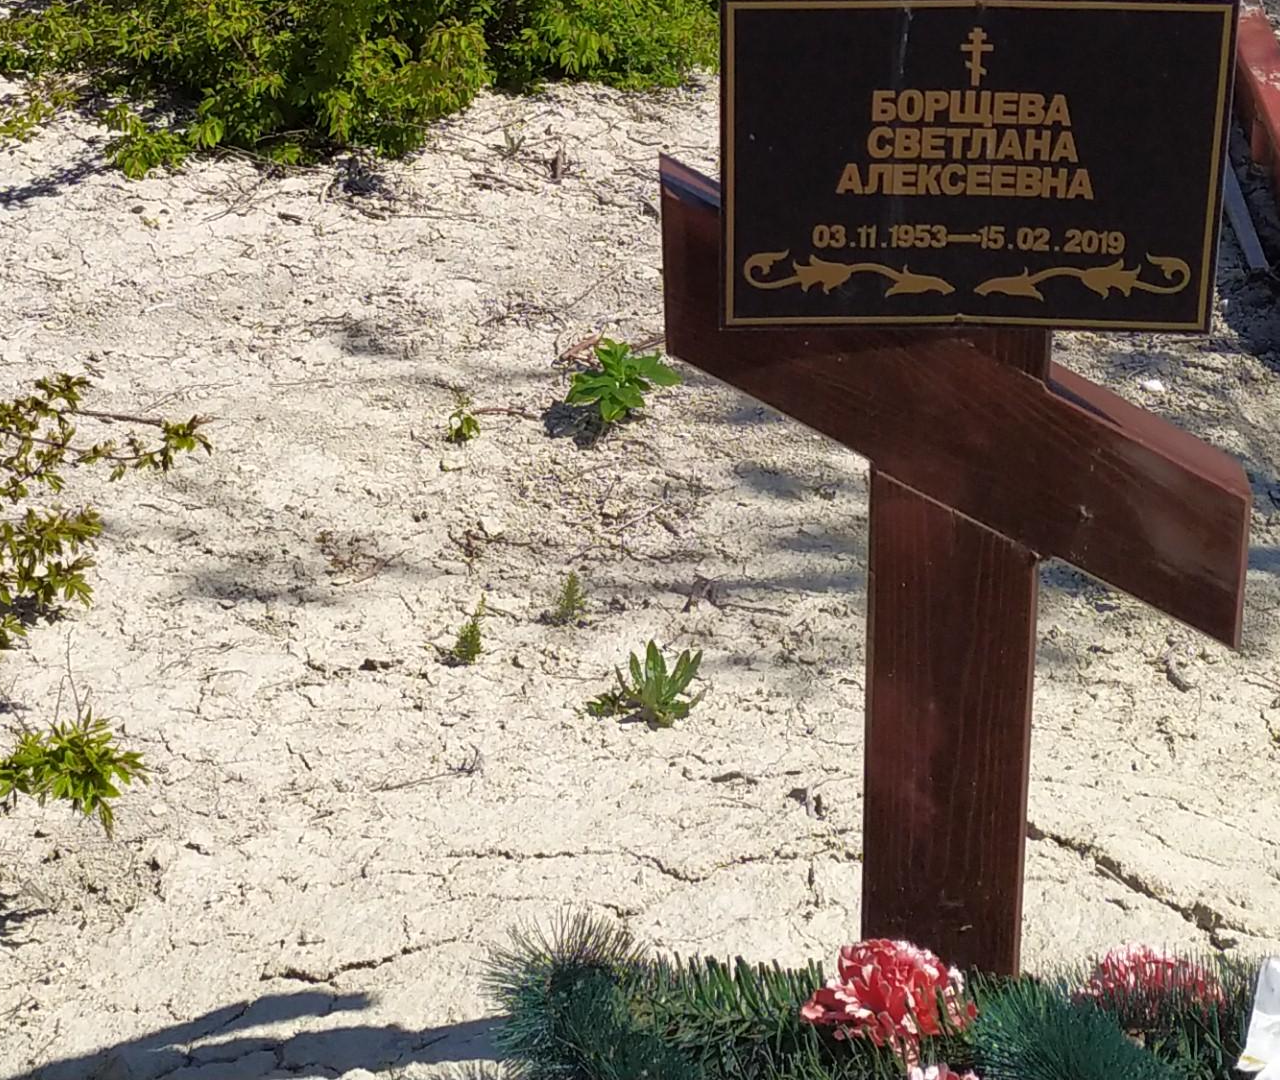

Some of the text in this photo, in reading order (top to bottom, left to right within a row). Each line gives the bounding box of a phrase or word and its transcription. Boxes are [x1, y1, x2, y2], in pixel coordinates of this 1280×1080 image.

[872, 89, 1072, 127] БОРЩЕВА
[867, 127, 1079, 163] СВЕТЛАНА
[835, 162, 1095, 200] АЛЕКСЕЕВНА
